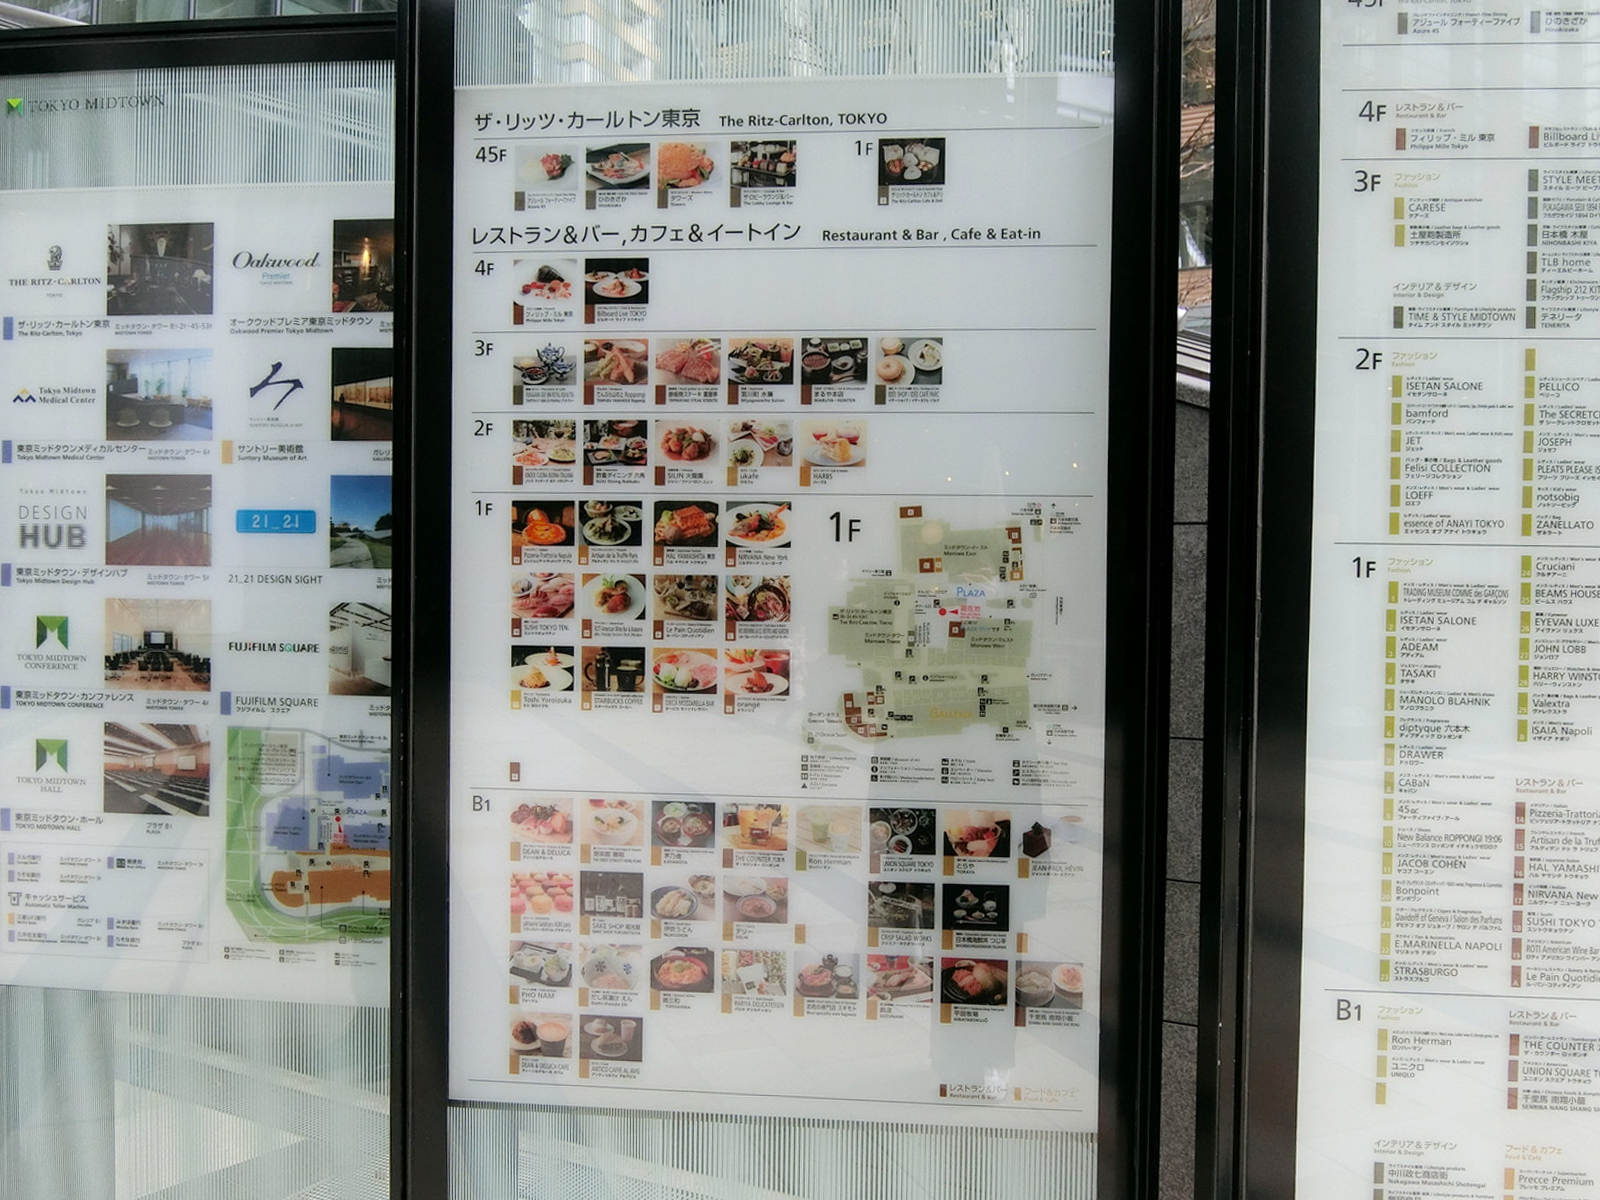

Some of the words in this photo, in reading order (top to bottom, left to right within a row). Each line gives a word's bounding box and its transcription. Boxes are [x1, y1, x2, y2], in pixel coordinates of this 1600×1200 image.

[28, 99, 79, 112] TOKYO
[85, 96, 165, 111] MIDTOWN
[1395, 103, 1436, 111] レストラン
[1438, 103, 1444, 111] &
[1447, 103, 1464, 111] バー
[1359, 101, 1386, 122] 4F
[474, 109, 700, 132] ザ・リッツ・カールトン東京
[719, 116, 743, 128] The
[749, 112, 833, 127] Ritz-Carlton,
[838, 112, 887, 125] TOKYO
[1479, 133, 1495, 142] 東京
[1544, 133, 1588, 141] Billboard
[855, 141, 873, 156] 1F
[476, 146, 507, 162] 45F
[1354, 170, 1381, 192] 3F
[1409, 203, 1445, 212] CARESE
[822, 230, 897, 241] Restaurant
[902, 229, 912, 240] &
[916, 229, 938, 240] Bar
[951, 229, 981, 239] Cafe
[987, 229, 996, 239] &
[1001, 228, 1041, 239] Eat-in
[232, 251, 319, 269] Oakwood
[1542, 258, 1559, 266] TLB
[474, 261, 494, 275] 4F
[262, 272, 290, 281] Premier
[1393, 283, 1433, 291] インテリア
[1444, 283, 1477, 291] デザイン
[1408, 313, 1429, 321] TIME
[1432, 313, 1439, 321] &
[1442, 313, 1465, 321] STYLE
[1467, 313, 1515, 321] MIDTOWN
[18, 320, 110, 329] ザ・リッツ・カールトン東京
[474, 340, 493, 356] 3F
[1355, 349, 1382, 370] 2F
[1406, 382, 1441, 390] ISETAN
[1444, 382, 1483, 390] SALONE
[1539, 383, 1579, 391] PELLICO
[39, 387, 60, 395] Tokyo
[1406, 409, 1448, 417] bamford
[474, 420, 493, 436] 2F
[1406, 437, 1420, 445] JET
[1538, 438, 1572, 446] JOSEPH
[238, 444, 303, 453] サントリー美術館
[1405, 464, 1427, 472] Felisi
[1430, 464, 1491, 472] COLLECTION
[1538, 465, 1563, 473] PLEATS
[1566, 465, 1593, 473] PLEASE
[1537, 493, 1579, 503] notsobig
[19, 506, 87, 519] DESIGN
[476, 501, 492, 515] 1F
[830, 512, 861, 542] 1F
[1404, 520, 1432, 528] essence
[1436, 519, 1444, 528] of
[1447, 520, 1473, 528] ANAYI
[1475, 520, 1504, 528] TOKYO
[1537, 521, 1594, 529] ZANELLATO
[20, 525, 86, 549] HUB
[1353, 557, 1376, 578] 1F
[1536, 562, 1575, 571] Cruciani
[258, 574, 292, 584] DESIGN
[295, 575, 322, 584] SIGHT
[956, 587, 986, 598] PLAZA
[1535, 589, 1567, 598] BEAMS
[1400, 616, 1435, 625] ISETAN
[1438, 616, 1477, 625] SALONE
[1535, 618, 1573, 627] EYEVAN
[1576, 618, 1599, 627] LUXE
[229, 642, 276, 652] FUJIFILM
[279, 643, 319, 653] SQUARE
[1401, 643, 1438, 651] ADEAM
[1534, 645, 1559, 653] JOHN
[1562, 646, 1586, 654] LOBB
[17, 654, 43, 662] TOKYO
[24, 662, 78, 670] CONFERENCE
[1401, 669, 1436, 677] TASAKI
[1533, 672, 1565, 680] HARRY
[236, 697, 276, 707] FUJIFILM
[279, 697, 318, 707] SQUARE
[1400, 696, 1444, 705] MANOLO
[1448, 697, 1491, 706] BLAHNIK
[1532, 699, 1570, 708] Valextra
[1399, 724, 1441, 734] diptyque
[1444, 725, 1470, 733] 六本木
[1532, 727, 1558, 735] ISAIA
[1561, 727, 1592, 736] Napoli
[1399, 751, 1443, 759] DRAWER
[45, 778, 86, 786] MIDTOWN
[473, 796, 490, 811] B1
[1416, 833, 1442, 842] Balance
[1445, 834, 1483, 842] ROPPONGI
[824, 858, 851, 866] Herman
[1397, 859, 1428, 868] JACOB
[1396, 887, 1439, 896] Bonpoint
[1527, 891, 1574, 900] NIRVANA
[1577, 892, 1598, 900] New
[1527, 918, 1556, 926] SUSHI
[1559, 919, 1595, 927] TOKYO
[1395, 939, 1461, 948] E.MARINELLA
[1465, 943, 1502, 951] NAPOLI
[1394, 967, 1458, 976] STRASBURGO
[1337, 999, 1362, 1021] B1
[1392, 1036, 1410, 1044] Ron
[1414, 1037, 1451, 1046] Herman
[1524, 1041, 1542, 1049] THE
[1546, 1042, 1594, 1051] COUNTER
[1523, 1067, 1552, 1076] UNION
[1555, 1068, 1590, 1077] SQUARE
[1519, 1176, 1549, 1184] Precce
[1552, 1177, 1594, 1186] Premium
